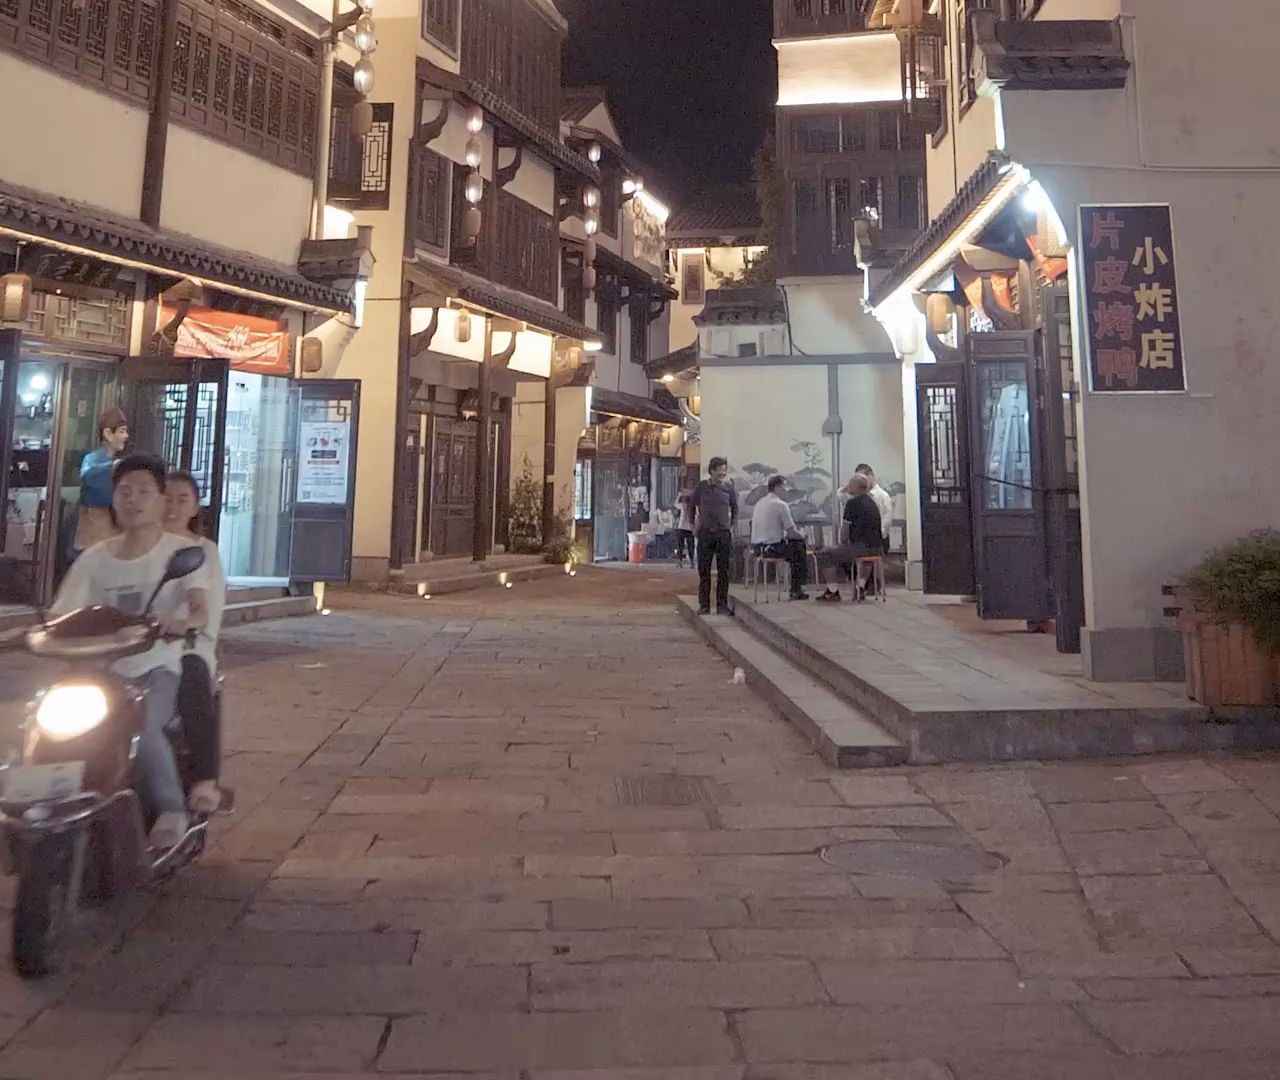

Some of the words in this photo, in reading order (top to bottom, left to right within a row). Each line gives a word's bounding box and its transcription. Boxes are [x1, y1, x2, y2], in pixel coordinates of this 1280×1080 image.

[1089, 211, 1138, 387] 片皮烤鸭
[1132, 237, 1175, 369] 小炸店
